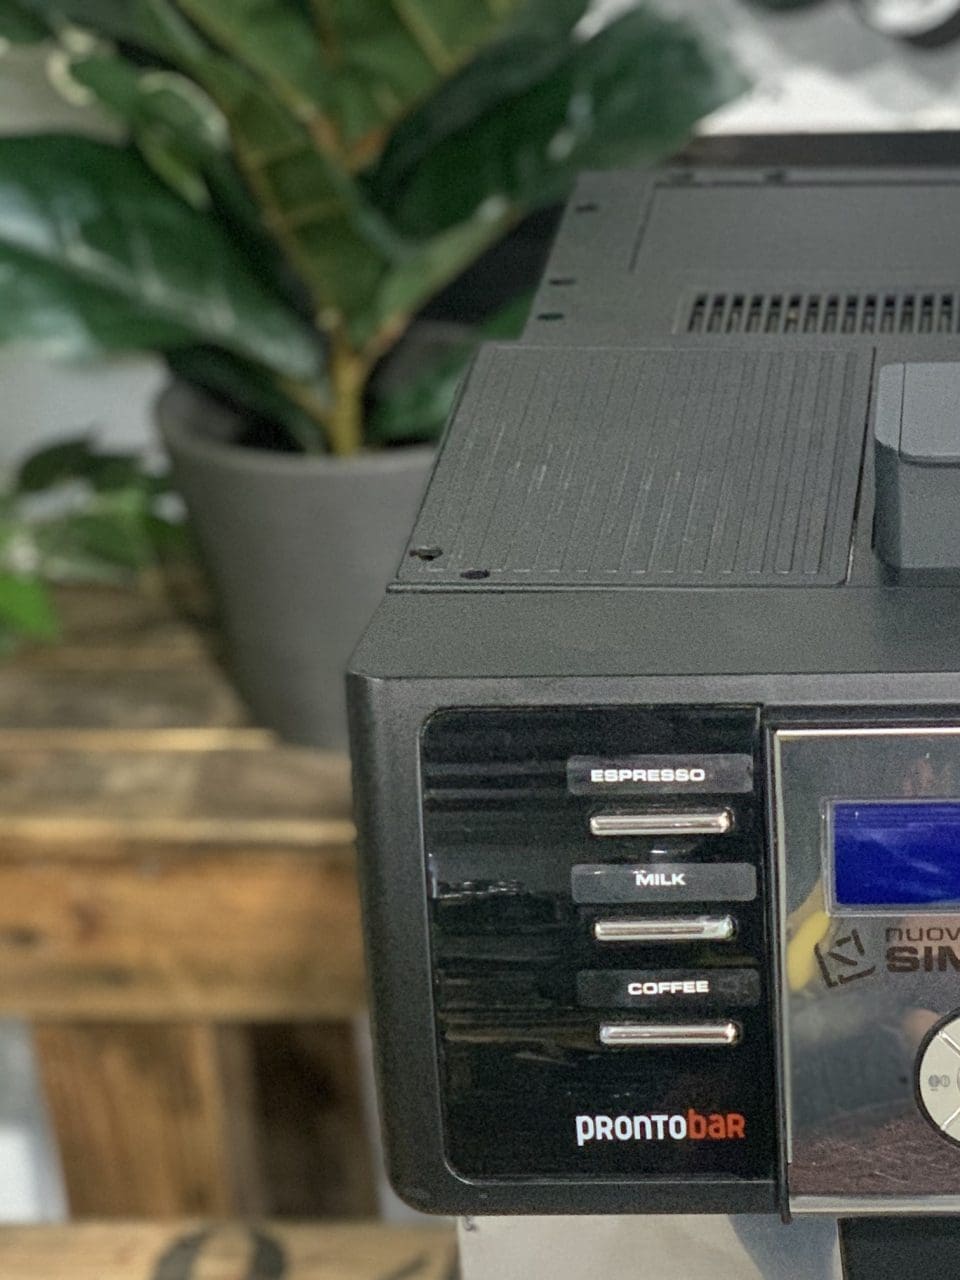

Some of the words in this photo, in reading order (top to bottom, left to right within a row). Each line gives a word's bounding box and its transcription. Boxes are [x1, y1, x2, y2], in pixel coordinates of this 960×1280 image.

[590, 767, 706, 783] ESPRESSO
[635, 872, 687, 887] MILK
[627, 979, 710, 996] COFFEE
